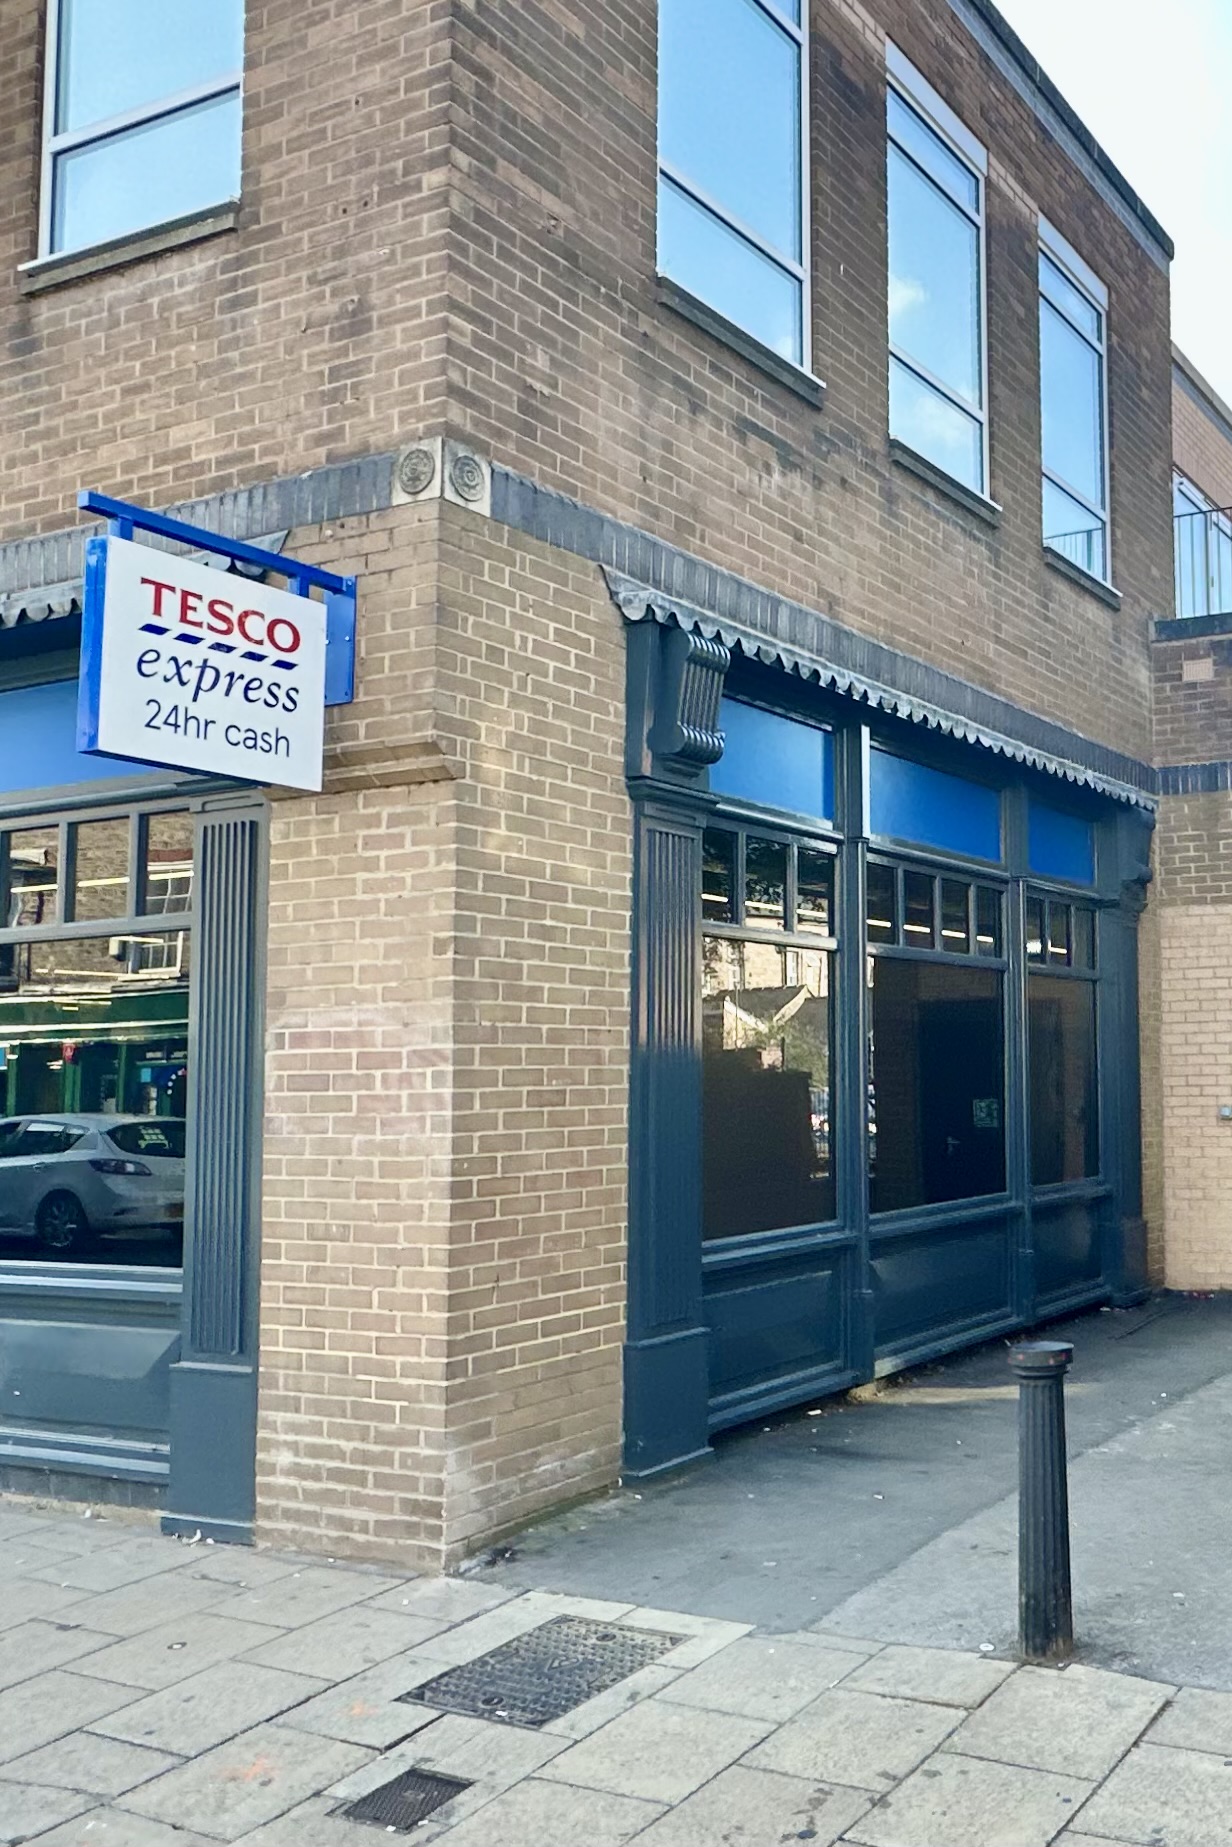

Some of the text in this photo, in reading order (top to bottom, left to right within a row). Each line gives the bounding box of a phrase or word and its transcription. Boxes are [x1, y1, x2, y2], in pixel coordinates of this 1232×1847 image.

[140, 577, 301, 654] TESCO
[136, 648, 300, 713] express
[144, 699, 290, 758] 24hr cash
